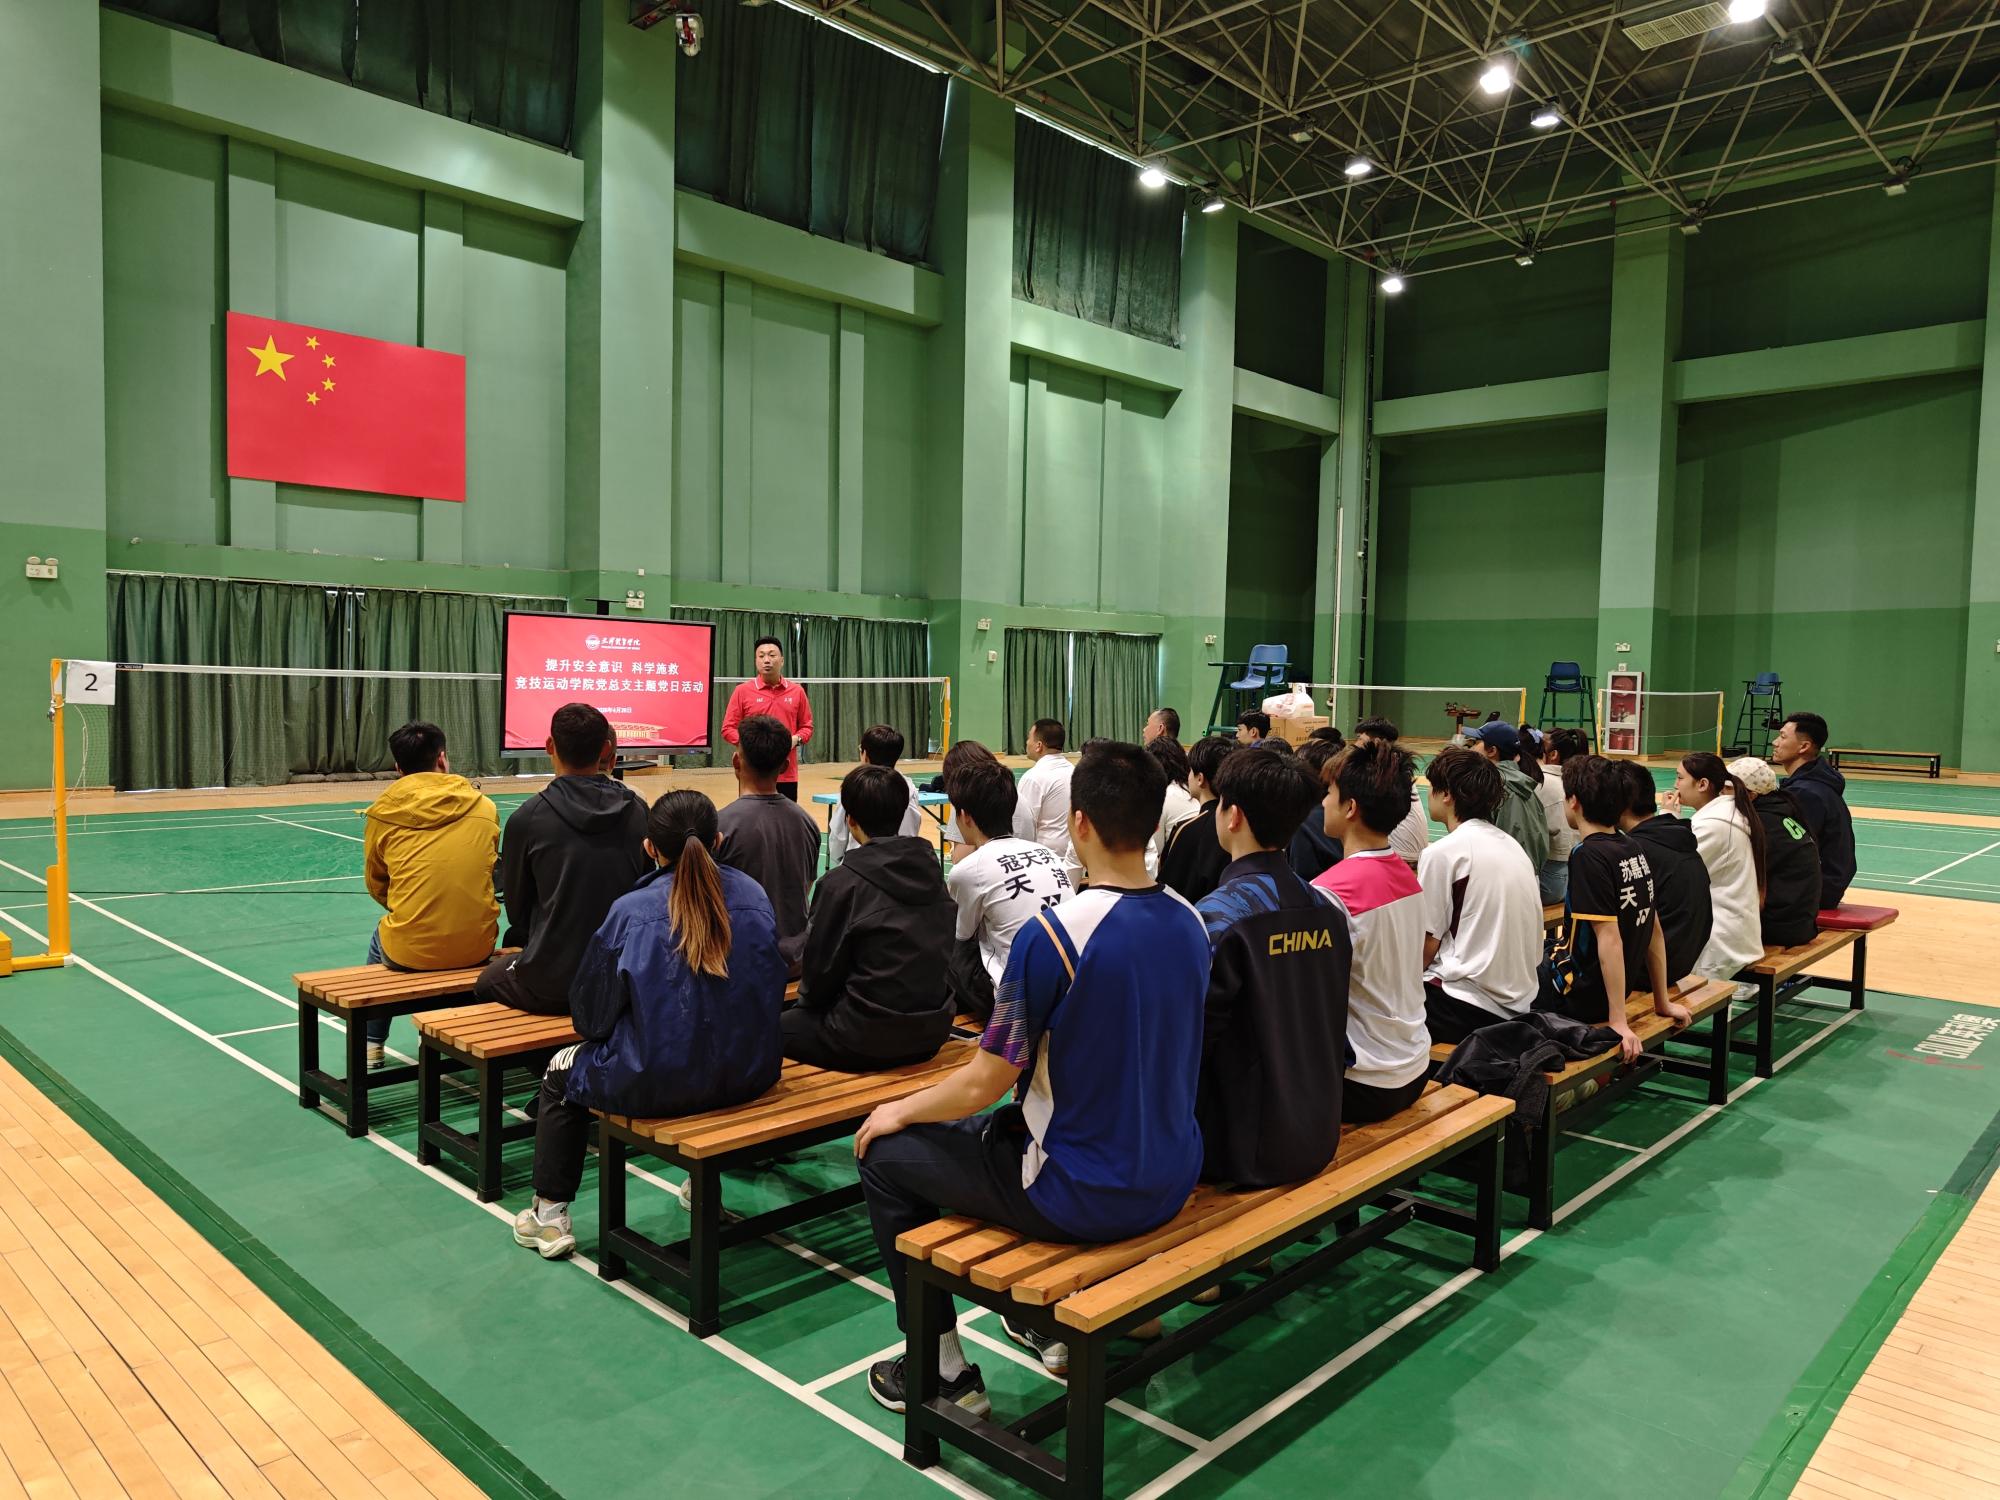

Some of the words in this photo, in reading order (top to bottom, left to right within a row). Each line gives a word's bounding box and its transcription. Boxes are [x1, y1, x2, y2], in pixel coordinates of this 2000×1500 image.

[545, 658, 623, 674] 提升安全意识
[84, 673, 98, 692] 2
[515, 676, 704, 693] 竞技运动学院党总支主题党日活动
[1269, 929, 1333, 956] CHINA
